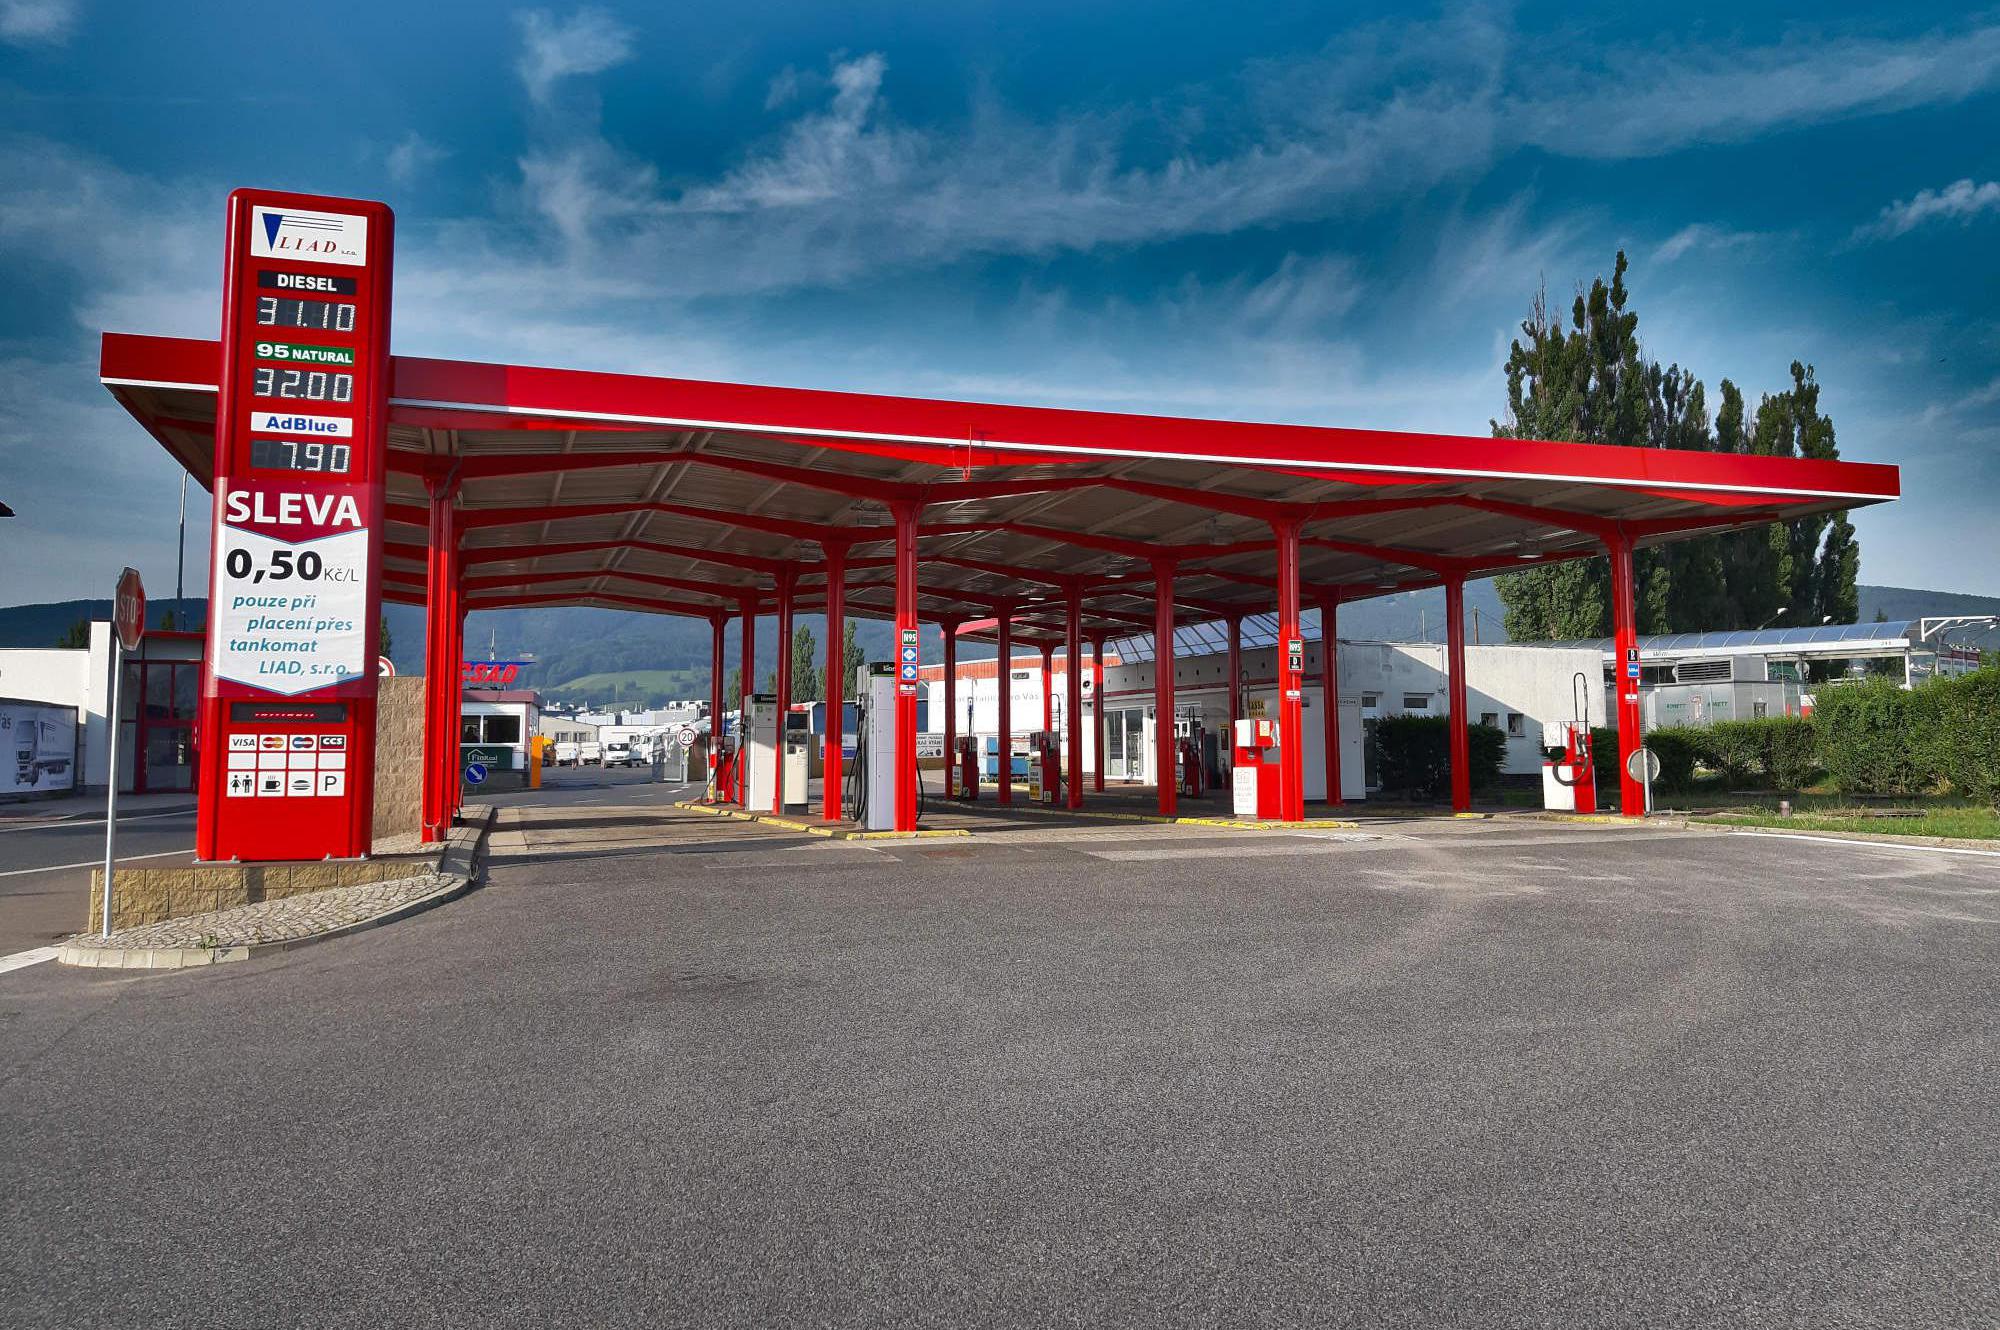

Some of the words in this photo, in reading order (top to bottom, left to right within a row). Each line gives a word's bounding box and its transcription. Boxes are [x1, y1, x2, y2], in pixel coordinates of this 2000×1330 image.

[279, 236, 337, 254] LIAD
[277, 273, 337, 292] DIESEL
[258, 297, 356, 332] 31.10
[256, 343, 290, 359] 95
[292, 348, 353, 364] NATURAL
[254, 368, 353, 402] 32.00
[265, 415, 338, 433] AdBlue
[281, 441, 350, 473] 7.90
[226, 490, 362, 527] SLEVA
[226, 548, 323, 585] 0,50
[324, 567, 359, 583] Kč/L
[120, 594, 142, 624] STOP
[232, 595, 287, 610] pouze
[291, 594, 316, 612] při
[247, 616, 313, 632] placení
[315, 616, 353, 632] přes
[229, 638, 318, 653] tankomat
[903, 633, 917, 643] N95
[259, 660, 306, 677] LIAD,
[310, 664, 351, 676] s.r.o.
[232, 738, 256, 747] VISA
[322, 737, 343, 745] CCS
[682, 732, 693, 742] 20
[324, 775, 337, 791] P
